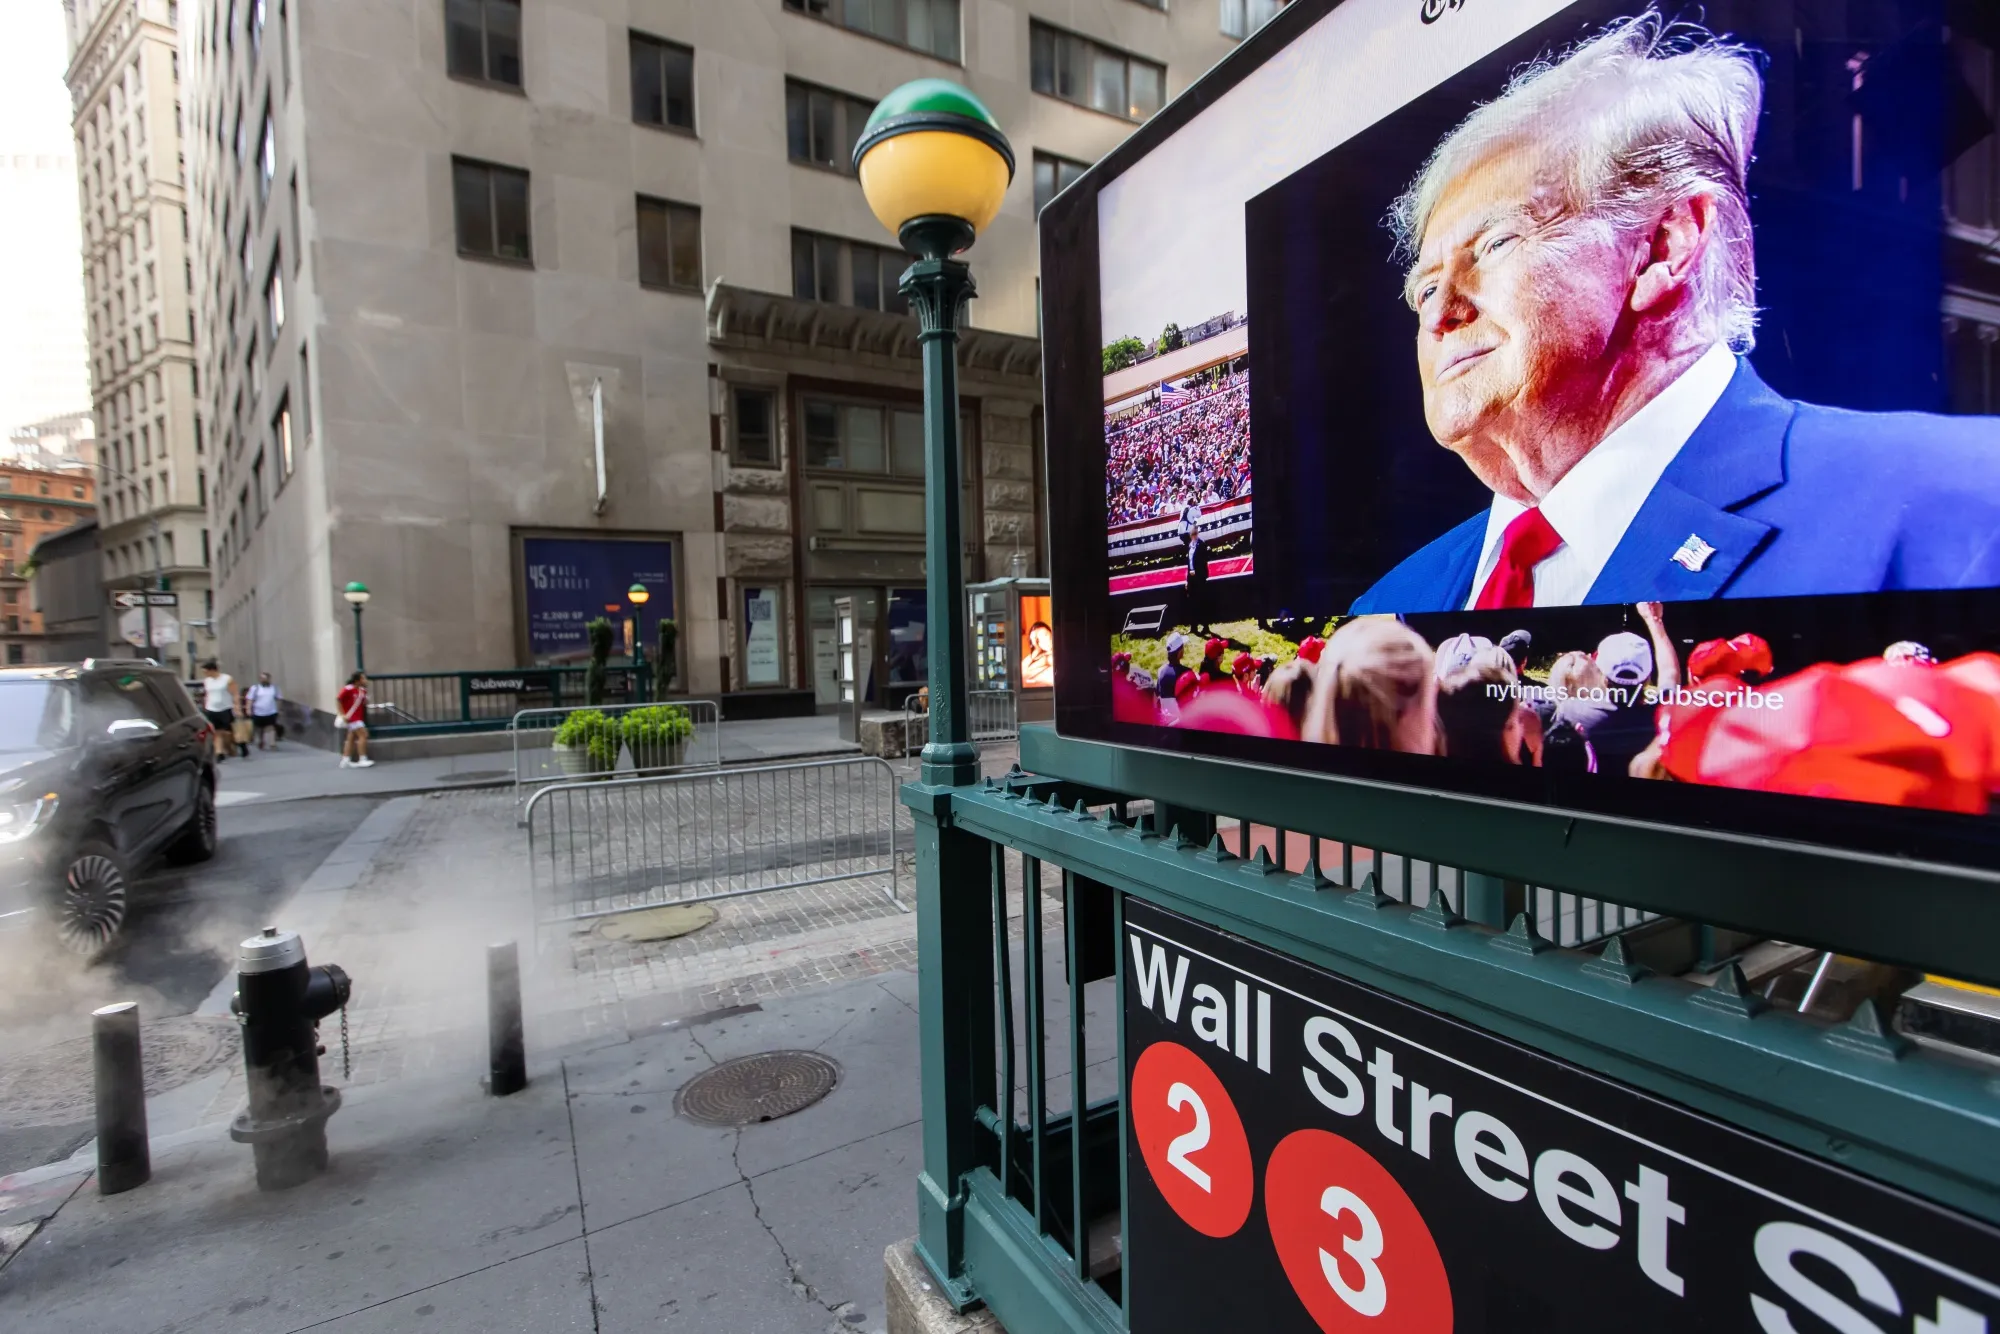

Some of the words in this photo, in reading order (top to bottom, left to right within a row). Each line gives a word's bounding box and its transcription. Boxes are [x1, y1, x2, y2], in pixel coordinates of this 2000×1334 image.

[529, 564, 548, 590] 45
[549, 565, 577, 576] WALL
[550, 577, 591, 590] STREET
[552, 632, 581, 640] Lease
[470, 678, 525, 690] Subway
[1486, 680, 1784, 710] nytimes.com/subscribe
[1129, 934, 1271, 1075] Wall
[1302, 1016, 1685, 1297] Street
[1166, 1082, 1212, 1194] 2
[1318, 1185, 1387, 1317] 3
